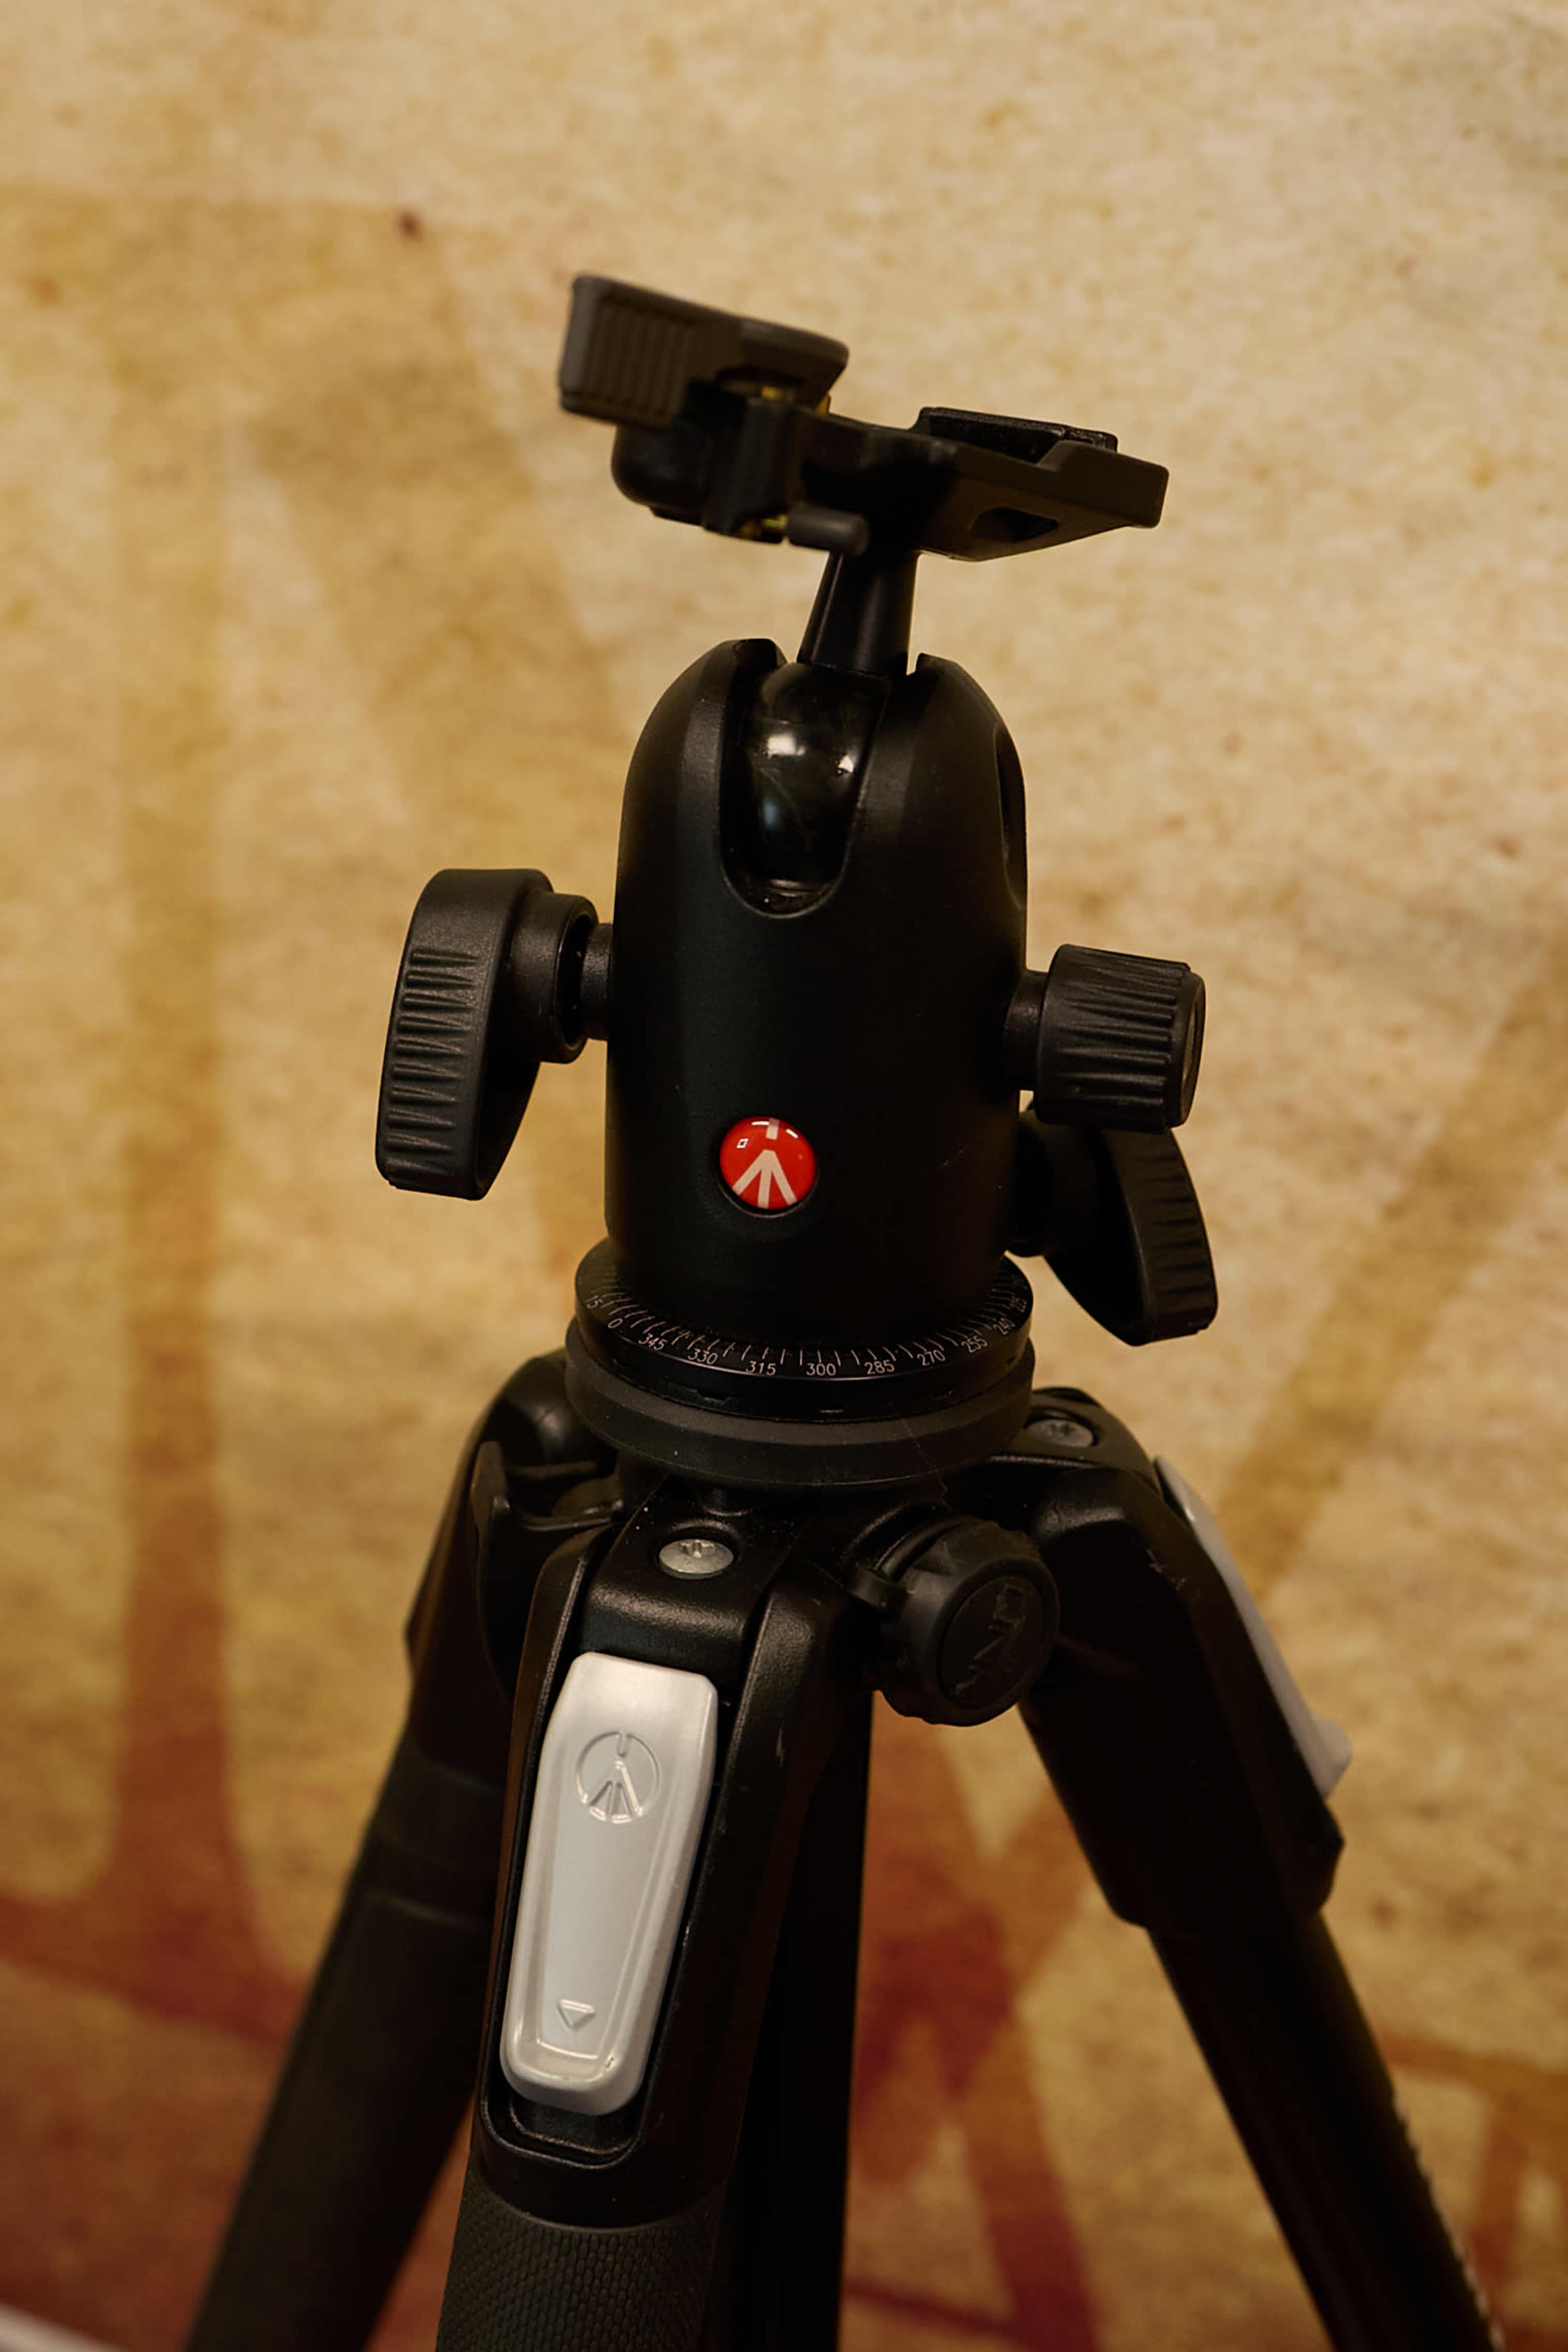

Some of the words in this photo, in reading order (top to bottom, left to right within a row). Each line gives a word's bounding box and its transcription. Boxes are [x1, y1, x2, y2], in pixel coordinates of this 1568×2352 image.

[607, 1317, 624, 1329] 0
[638, 1333, 668, 1351] 345
[688, 1349, 718, 1365] 330
[745, 1360, 777, 1376] 315
[806, 1363, 836, 1376] 300
[864, 1359, 895, 1375] 285
[917, 1349, 946, 1367] 270
[961, 1335, 988, 1353] 255
[993, 1318, 1016, 1335] 240
